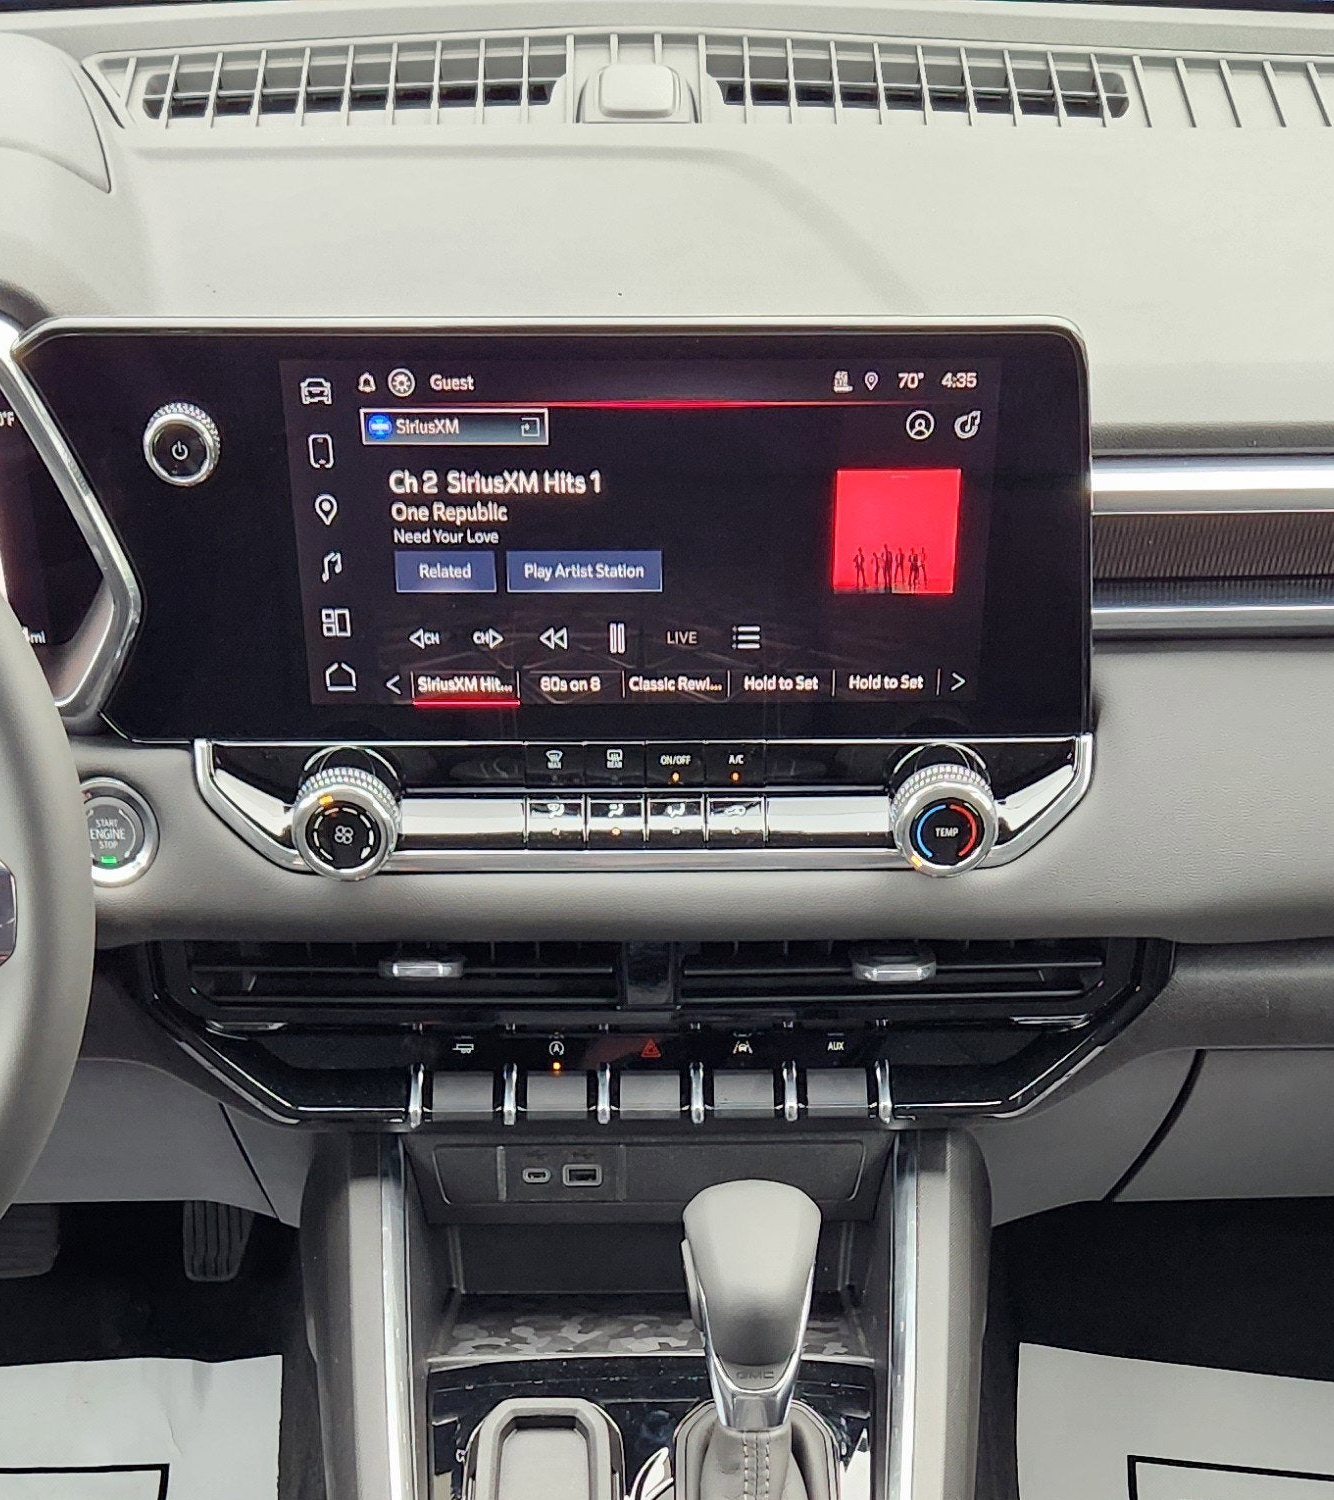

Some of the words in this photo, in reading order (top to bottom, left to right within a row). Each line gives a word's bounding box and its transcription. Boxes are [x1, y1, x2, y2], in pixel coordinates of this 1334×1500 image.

[429, 374, 475, 392] Guest
[941, 372, 977, 388] 4:35
[396, 418, 459, 435] SiriusXM
[388, 469, 418, 495] Ch
[422, 470, 438, 494] 2
[447, 469, 539, 495] SiriusXM
[543, 469, 587, 495] Hits
[589, 469, 603, 494] 1
[391, 501, 429, 522] One
[432, 501, 508, 526] Republic
[393, 528, 431, 544] Need
[433, 528, 464, 544] Your
[467, 528, 499, 544] Love
[419, 562, 472, 579] Related
[524, 562, 552, 582] Play
[554, 562, 593, 579] Artist
[596, 562, 645, 579] Station
[666, 631, 697, 645] LIVE
[417, 676, 480, 693] SiriusXM
[540, 676, 568, 692] 80s
[569, 679, 587, 692] on
[589, 676, 602, 692] 8
[628, 676, 676, 693] Classic
[744, 674, 775, 691] Hold
[778, 676, 794, 691] to
[795, 675, 819, 691] Set
[848, 673, 881, 690] Hold
[883, 674, 898, 690] to
[900, 673, 924, 690] Set
[660, 755, 691, 765] ON/OFF
[729, 755, 744, 765] A/C
[95, 819, 119, 828] START
[90, 828, 126, 840] ENGINE
[935, 828, 959, 837] TEMP
[99, 841, 118, 850] STOP
[827, 1041, 845, 1052] AUX
